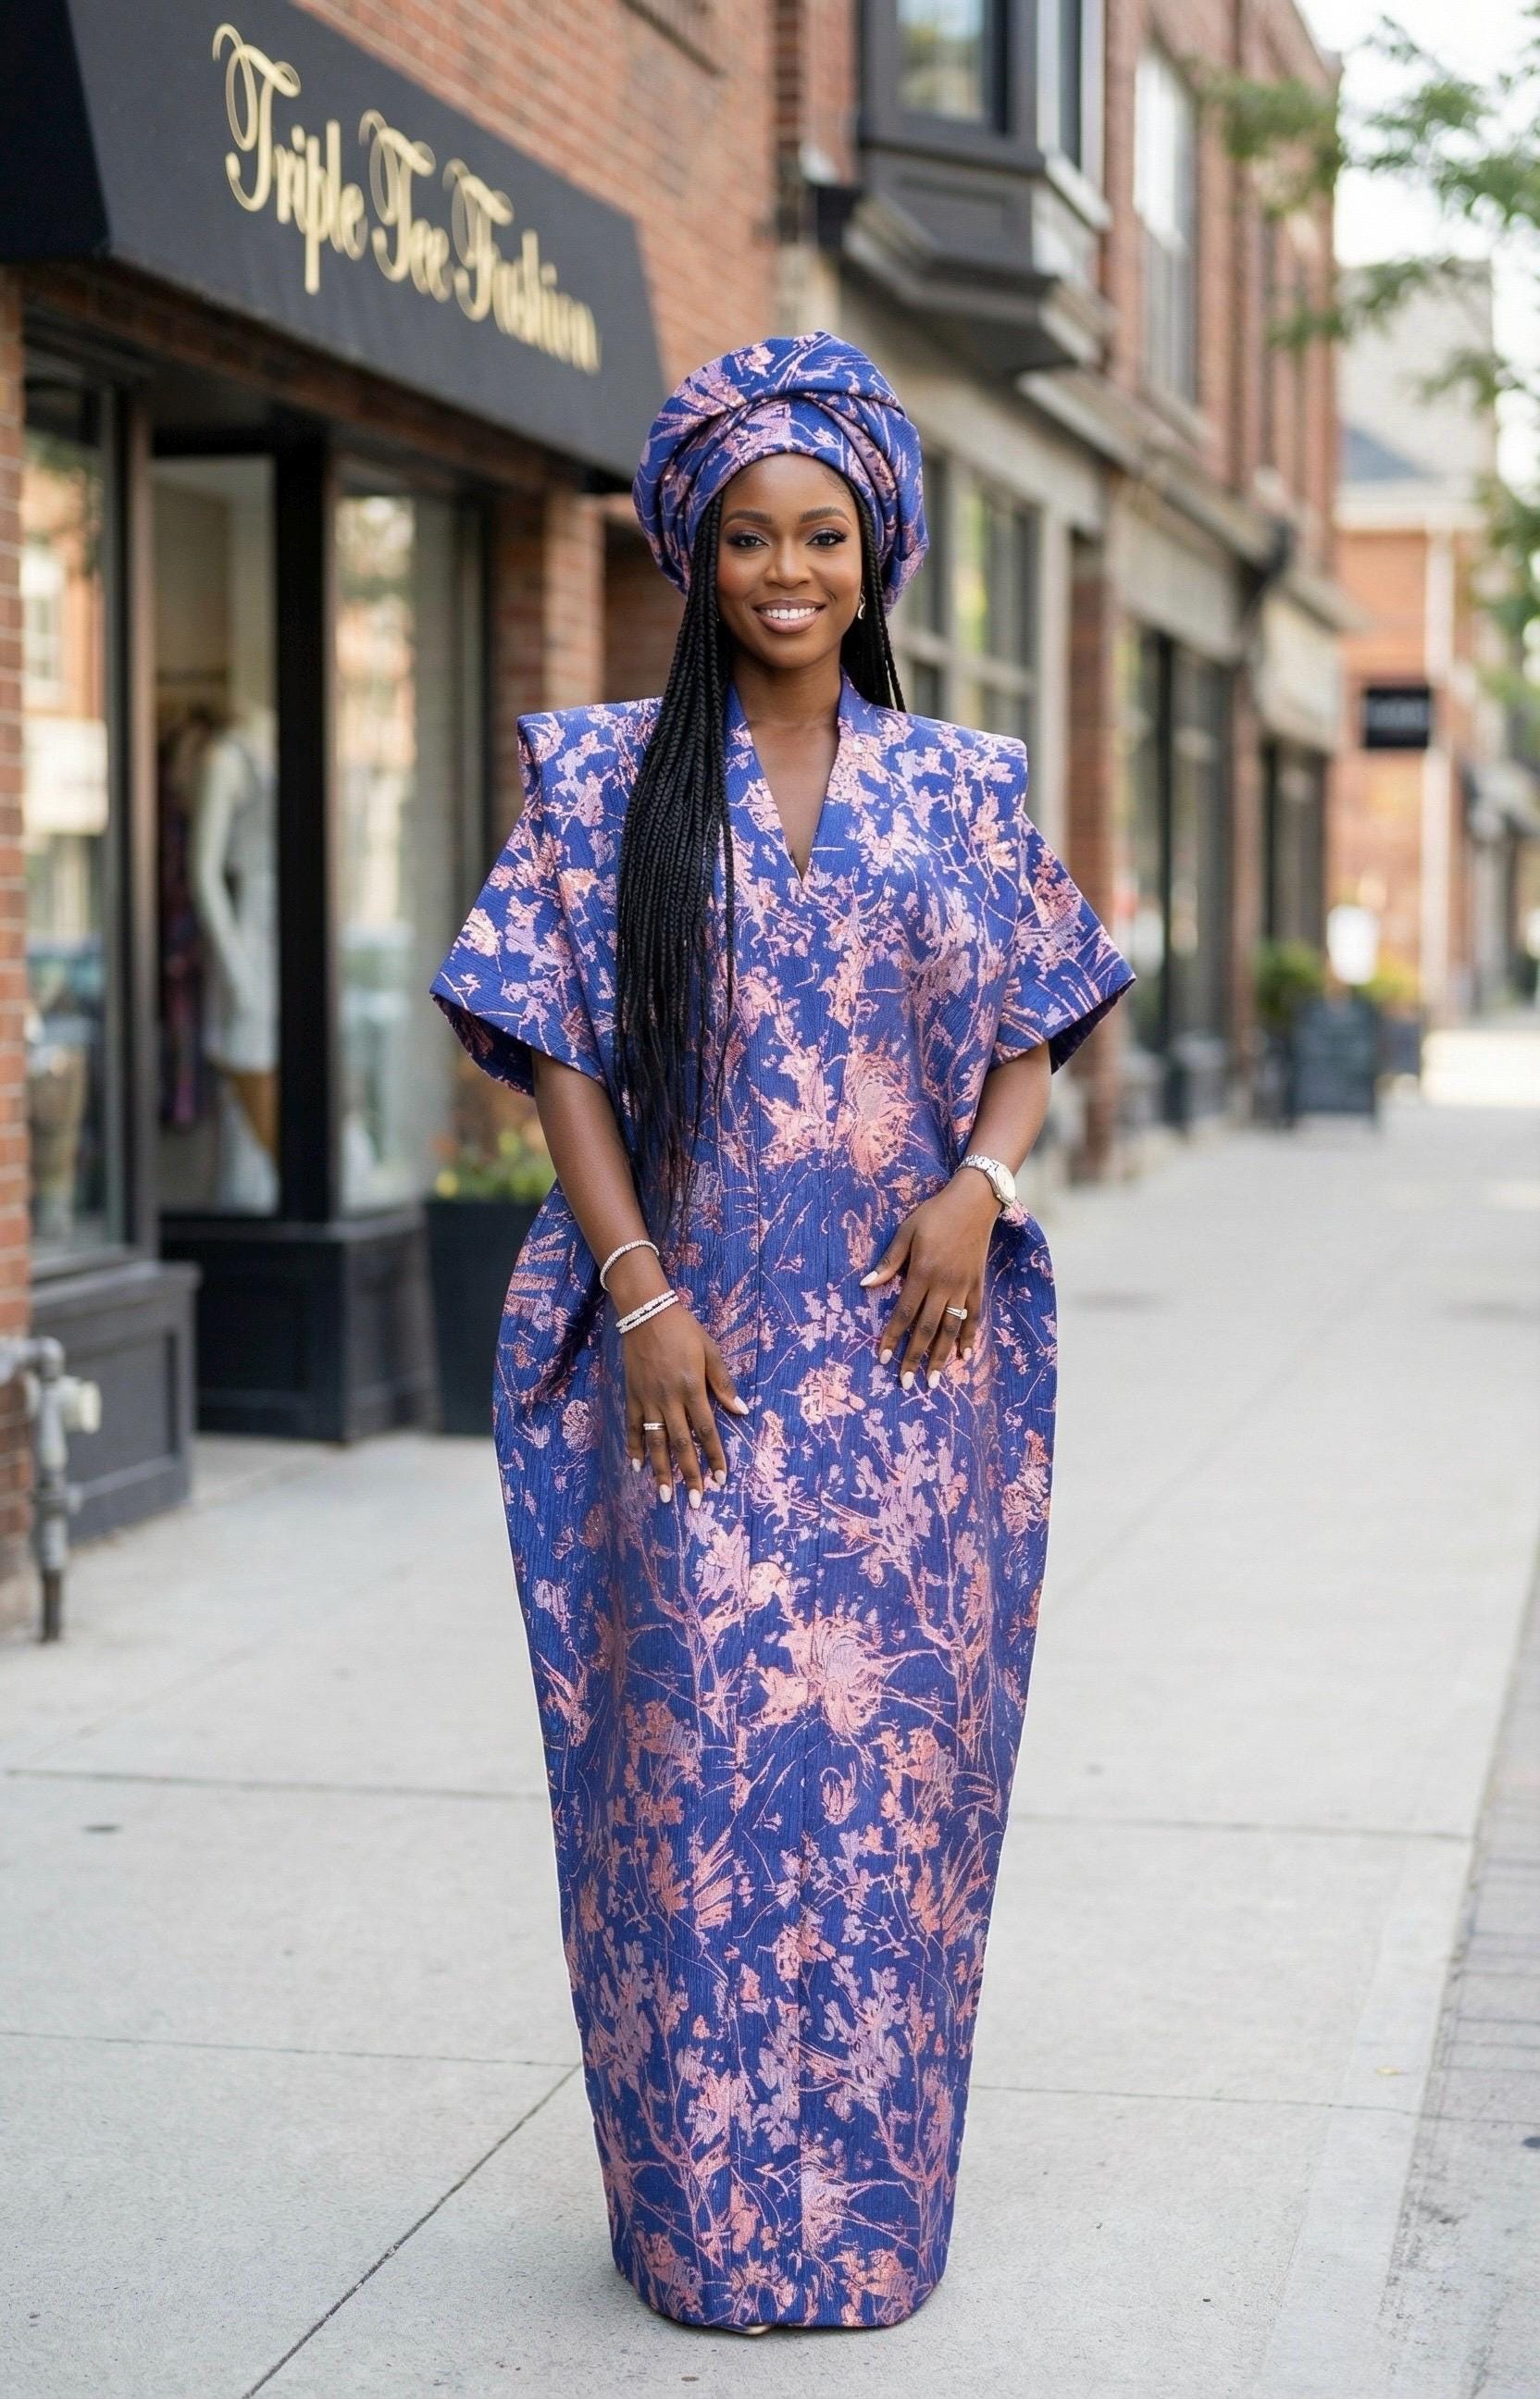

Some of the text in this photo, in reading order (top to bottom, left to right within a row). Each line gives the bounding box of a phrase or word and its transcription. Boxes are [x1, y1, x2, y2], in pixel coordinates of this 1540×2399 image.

[212, 23, 600, 375] Triple Tee Fashion
